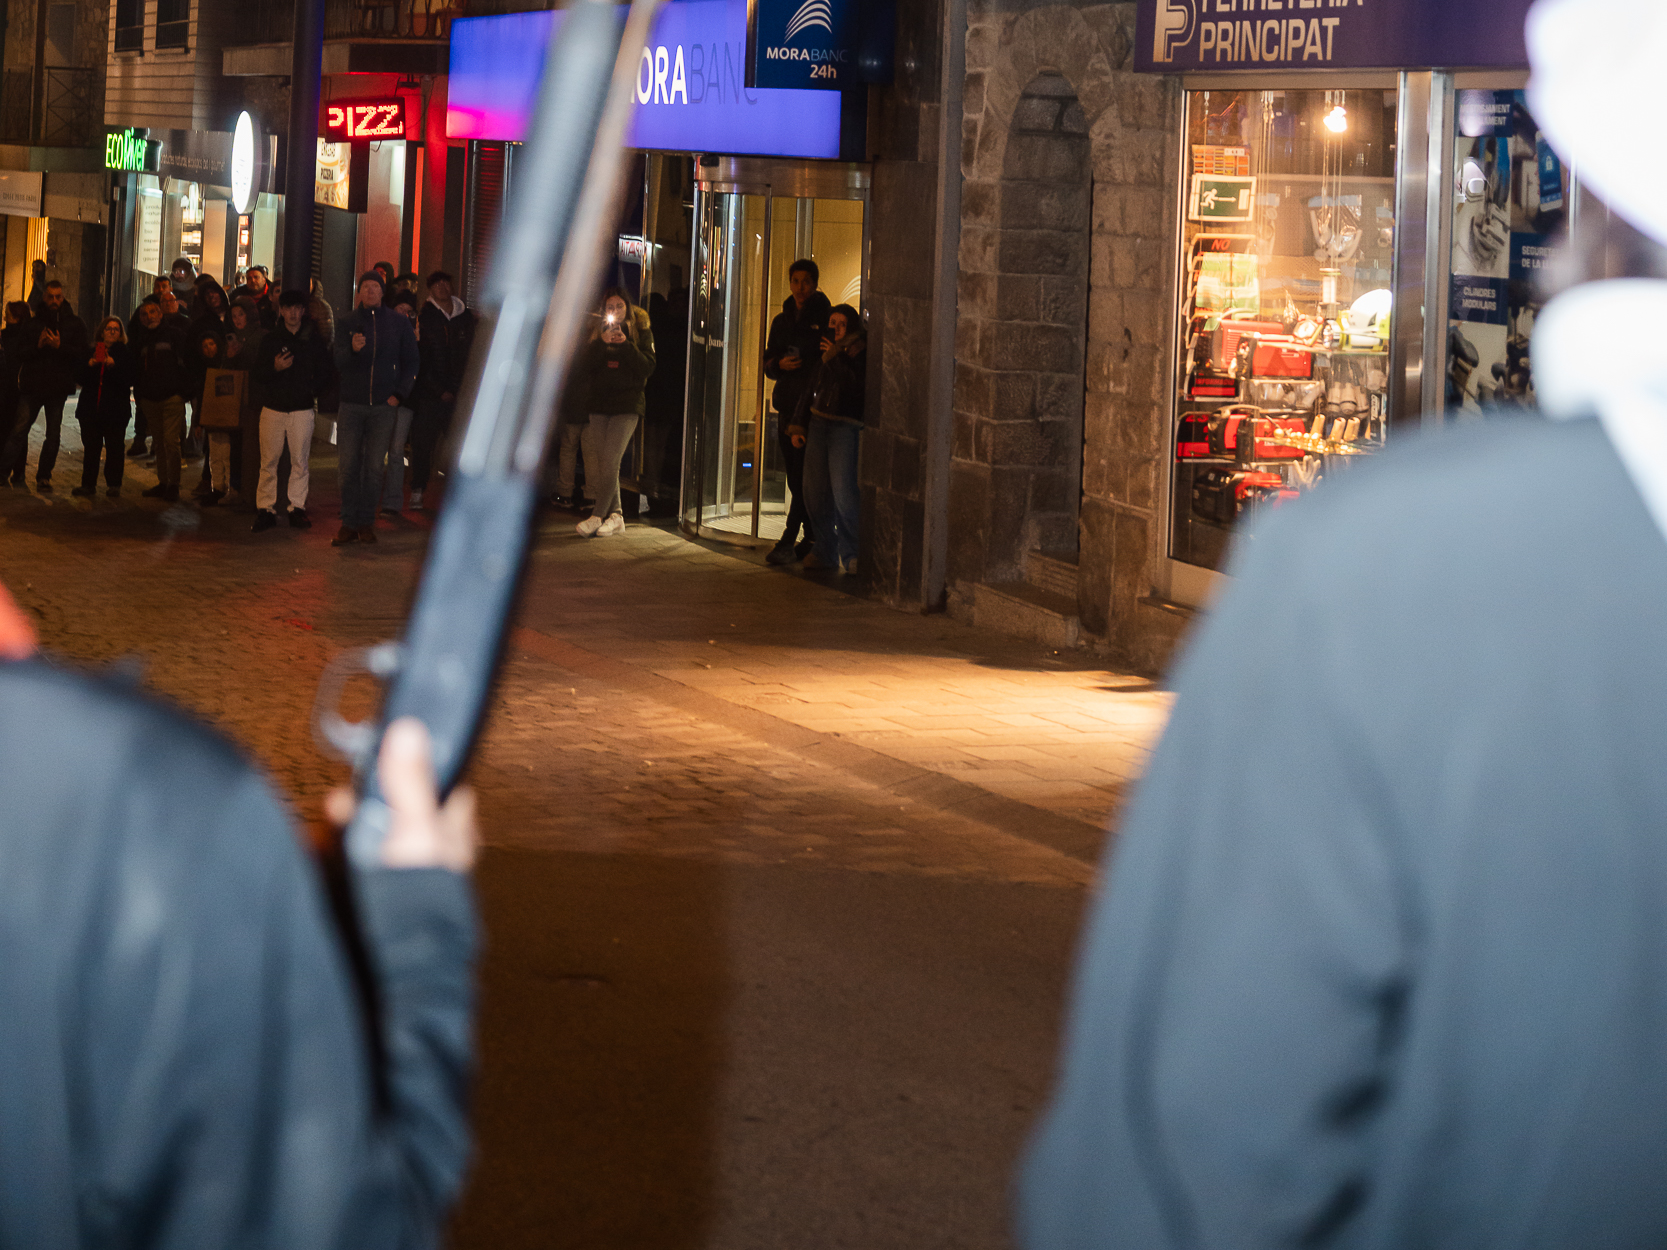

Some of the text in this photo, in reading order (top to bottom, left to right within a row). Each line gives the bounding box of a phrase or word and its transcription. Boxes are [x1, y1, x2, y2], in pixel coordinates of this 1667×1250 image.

[1199, 17, 1340, 62] PRINCIPAT
[766, 47, 848, 62] MORABANC
[630, 41, 758, 105] ORABAN
[809, 64, 837, 79] 24h
[1211, 238, 1231, 251] NO
